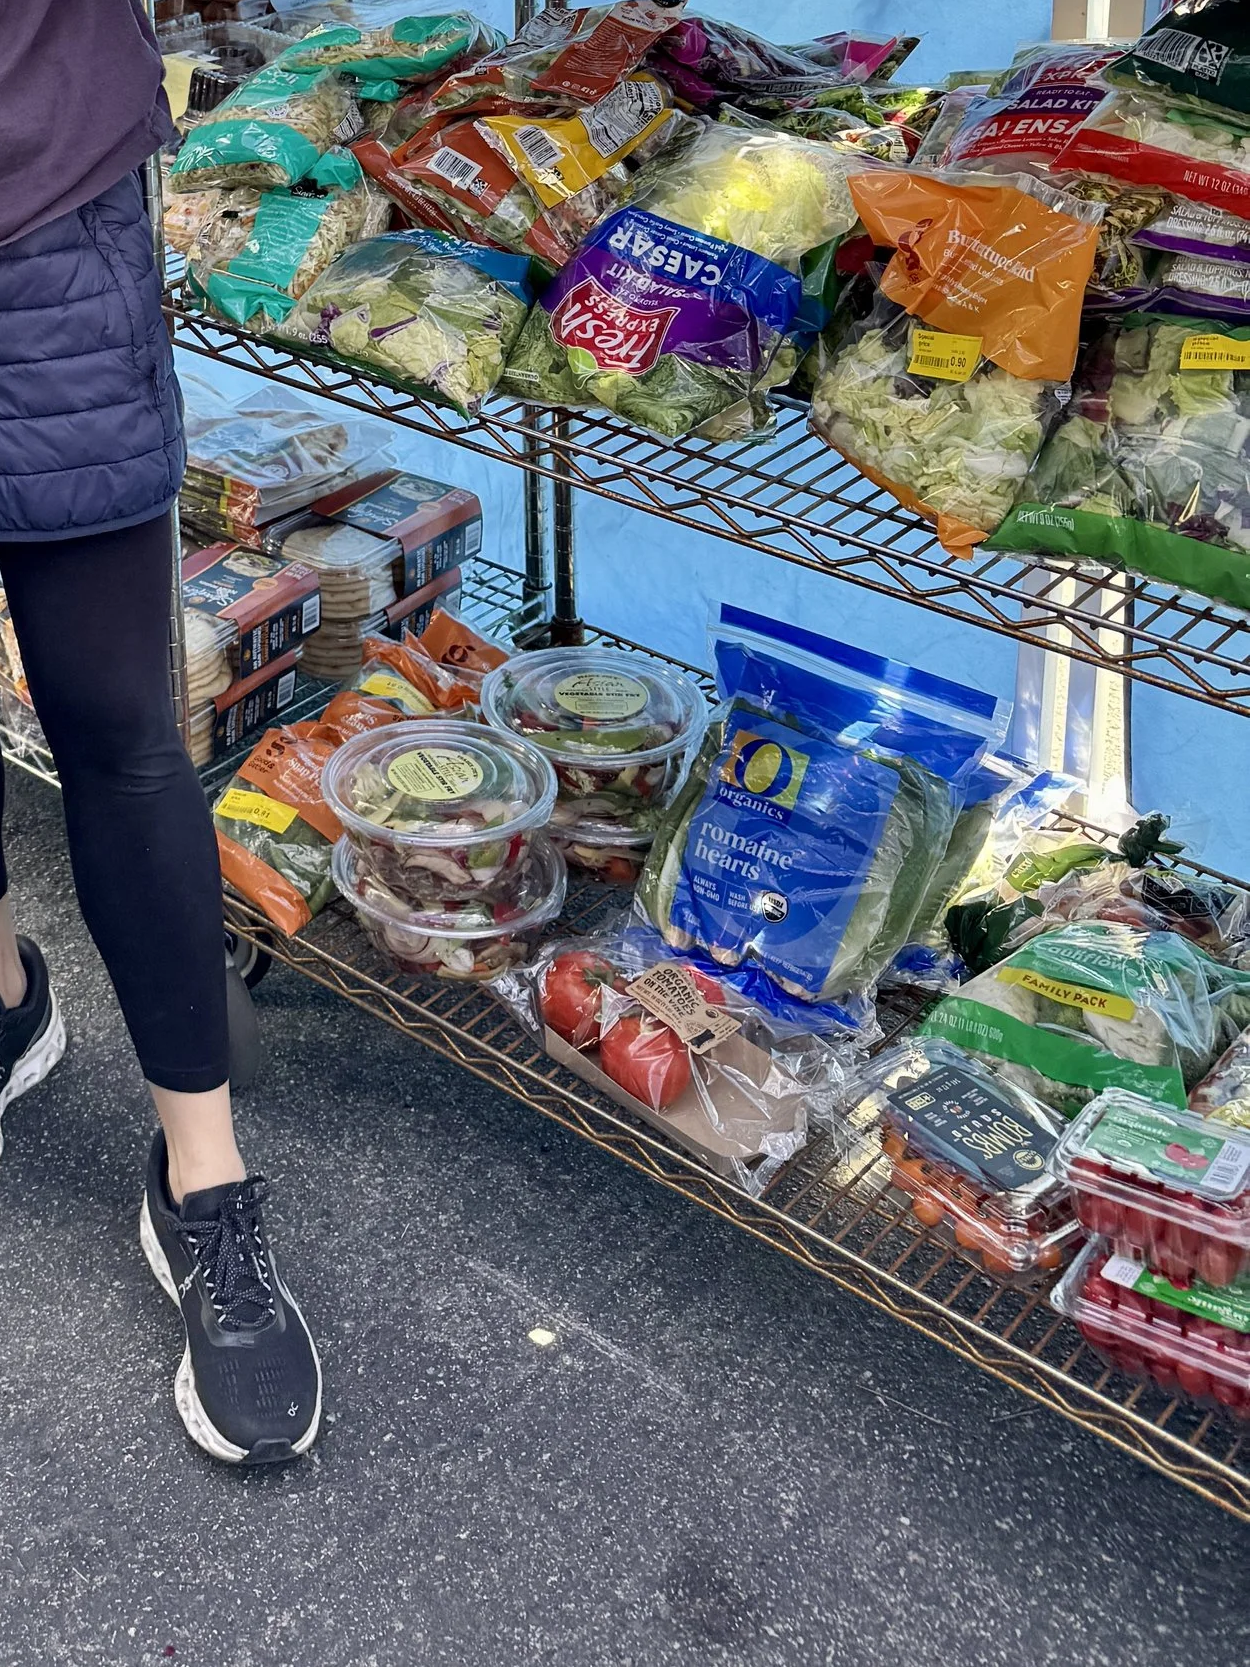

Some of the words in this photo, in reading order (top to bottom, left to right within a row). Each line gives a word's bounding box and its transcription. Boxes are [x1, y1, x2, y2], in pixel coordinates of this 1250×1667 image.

[1008, 98, 1066, 110] SALAD
[1070, 99, 1100, 110] KIT
[1183, 170, 1194, 183] NET
[1211, 177, 1220, 191] 12
[1220, 180, 1231, 193] OZ
[608, 225, 722, 286] CAESAR
[607, 263, 636, 285] KIT
[584, 294, 660, 333] EXPRESS
[561, 302, 656, 368] Fresh
[950, 356, 967, 368] 0.90
[416, 751, 440, 776] VEGETABLE
[734, 738, 793, 798] O
[718, 785, 784, 821] organics
[693, 838, 761, 882] hearts
[699, 820, 794, 871] romaine
[692, 884, 720, 902] NON-GMO
[693, 874, 717, 891] ALWAYS
[728, 890, 746, 902] WASH
[727, 898, 749, 911] BEFORE
[643, 977, 654, 987] ON
[654, 984, 668, 999] THE
[652, 969, 696, 1015] TOMATOES
[663, 968, 700, 1009] ORGANIC
[1022, 974, 1072, 999] FAMILY
[1073, 993, 1108, 1009] PACK
[939, 1014, 948, 1024] 24
[949, 1016, 958, 1027] OZ
[952, 1108, 1002, 1142] SQUAD
[961, 1115, 1034, 1160] BOMBS
